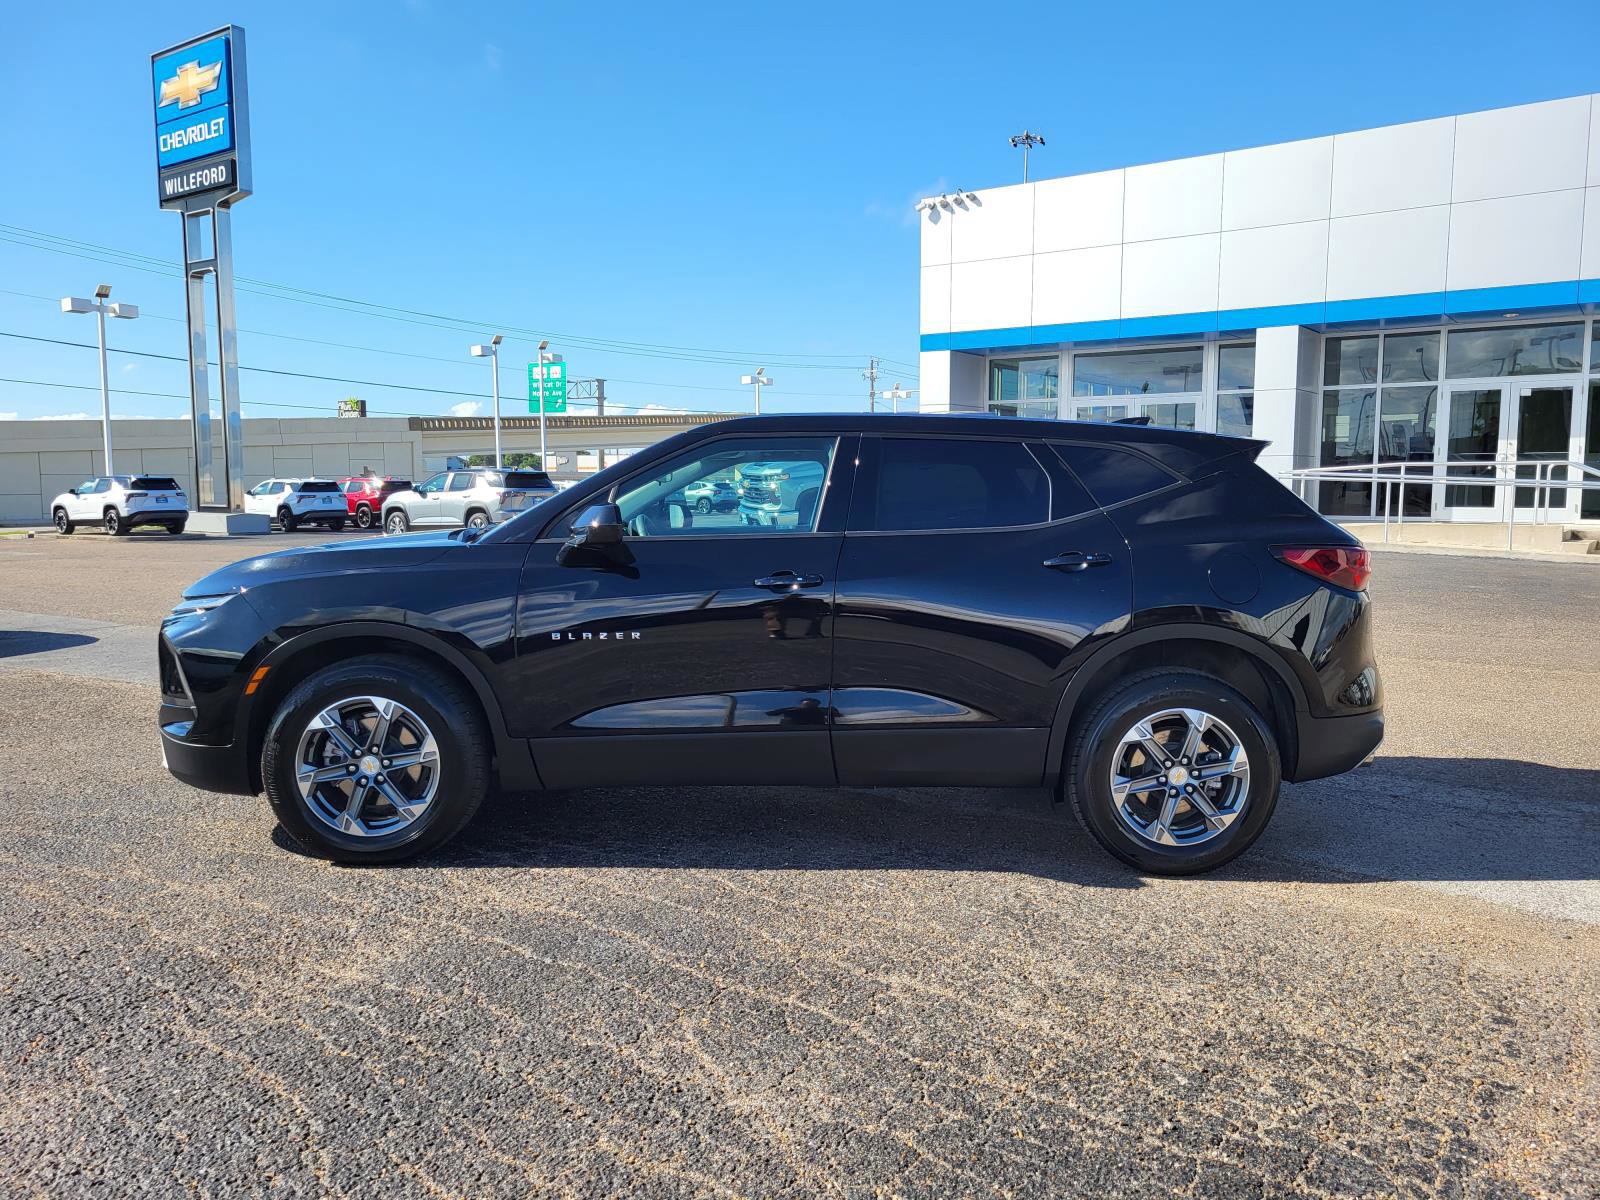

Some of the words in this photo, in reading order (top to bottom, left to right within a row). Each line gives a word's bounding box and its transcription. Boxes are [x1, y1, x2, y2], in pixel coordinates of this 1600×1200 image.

[160, 117, 225, 152] CHEVROLET
[165, 165, 226, 196] WILLEFORD
[551, 632, 641, 640] BLAZER
